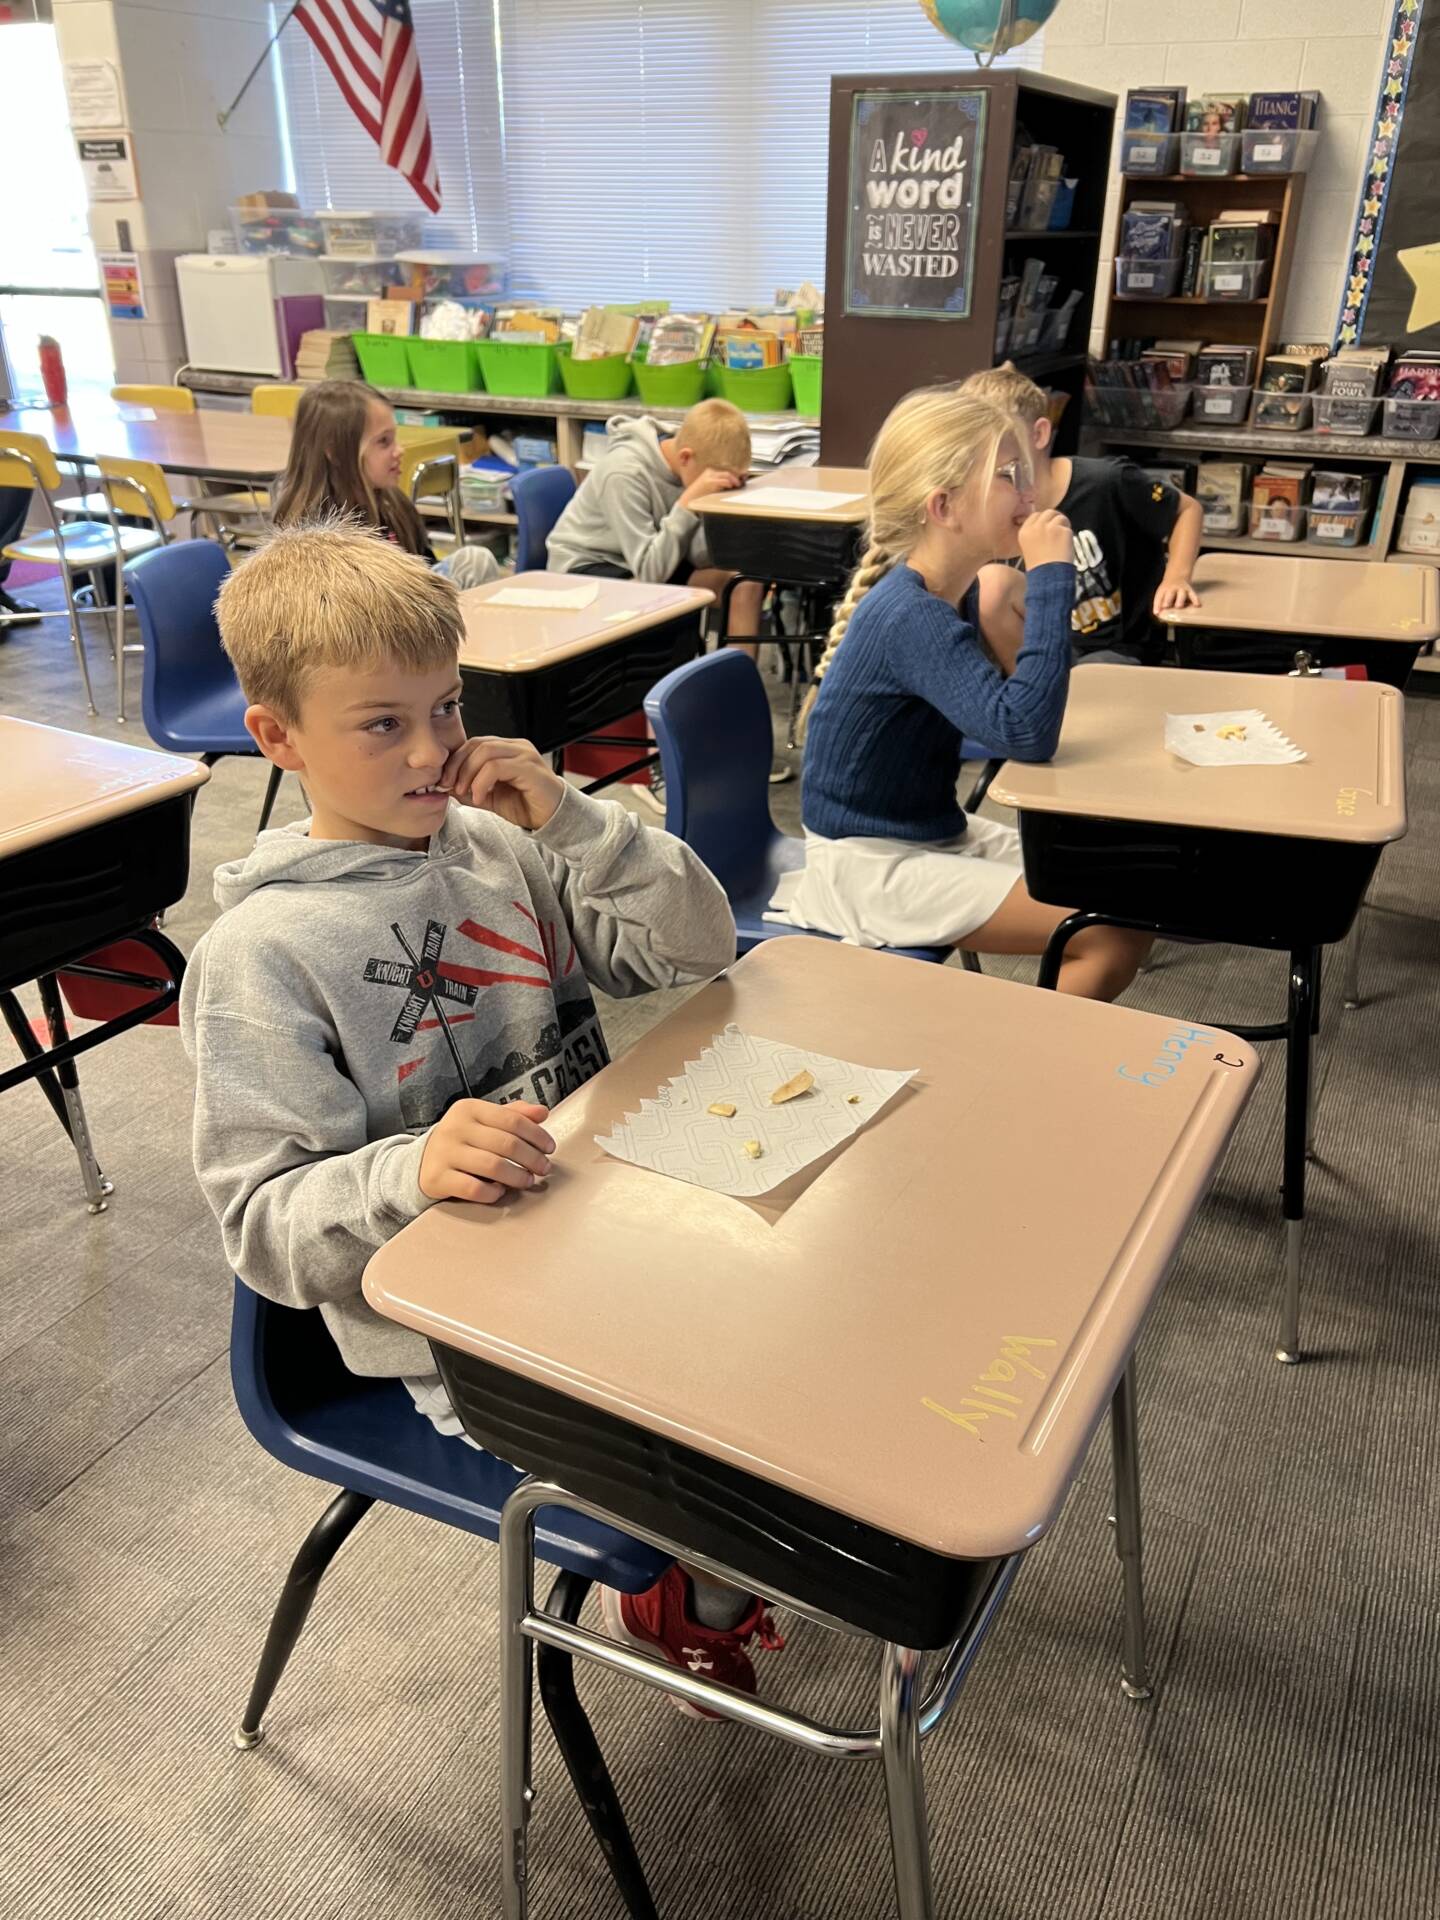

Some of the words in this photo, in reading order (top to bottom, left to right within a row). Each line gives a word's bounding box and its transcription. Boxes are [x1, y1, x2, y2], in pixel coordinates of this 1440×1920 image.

[1255, 98, 1297, 116] TITANIC
[869, 138, 887, 173] A
[890, 131, 967, 175] kind
[866, 172, 963, 210] word
[868, 220, 882, 241] is
[884, 213, 960, 251] NEVER
[862, 252, 959, 278] WASTED
[1399, 367, 1440, 378] HADDI
[1331, 386, 1364, 397] FOWL
[424, 929, 443, 961] TRAIN
[374, 963, 413, 986] KNIGHT
[444, 979, 468, 1001] TRAIN
[397, 993, 426, 1033] KNIGHT
[1116, 1025, 1217, 1088] Henry
[921, 1335, 1057, 1436] Wally
